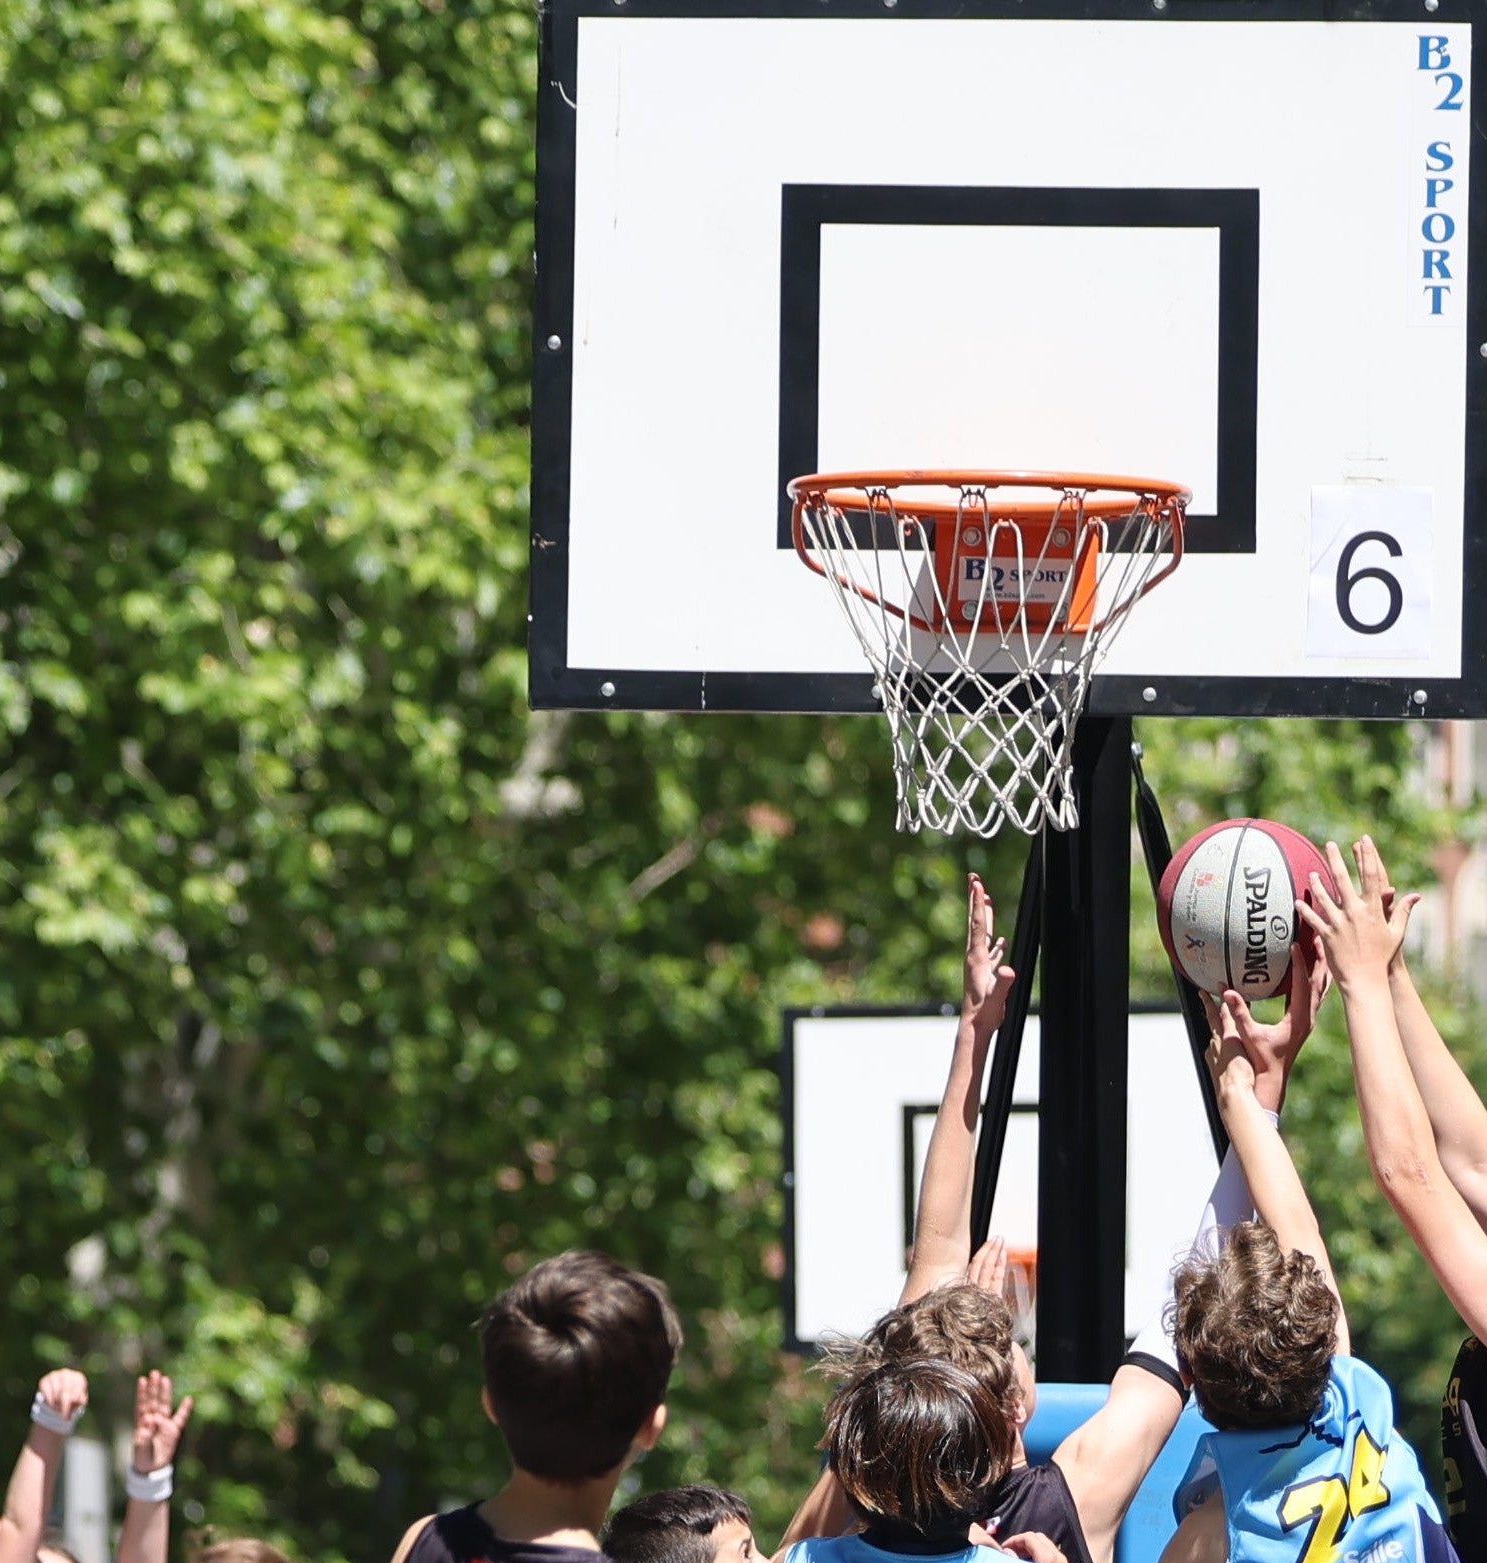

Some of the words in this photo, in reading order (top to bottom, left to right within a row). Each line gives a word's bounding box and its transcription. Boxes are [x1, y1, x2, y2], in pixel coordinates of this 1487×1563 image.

[1416, 35, 1464, 111] B2
[1421, 140, 1456, 315] SPORT
[1335, 530, 1404, 635] 6
[1242, 866, 1272, 986] SPALDING
